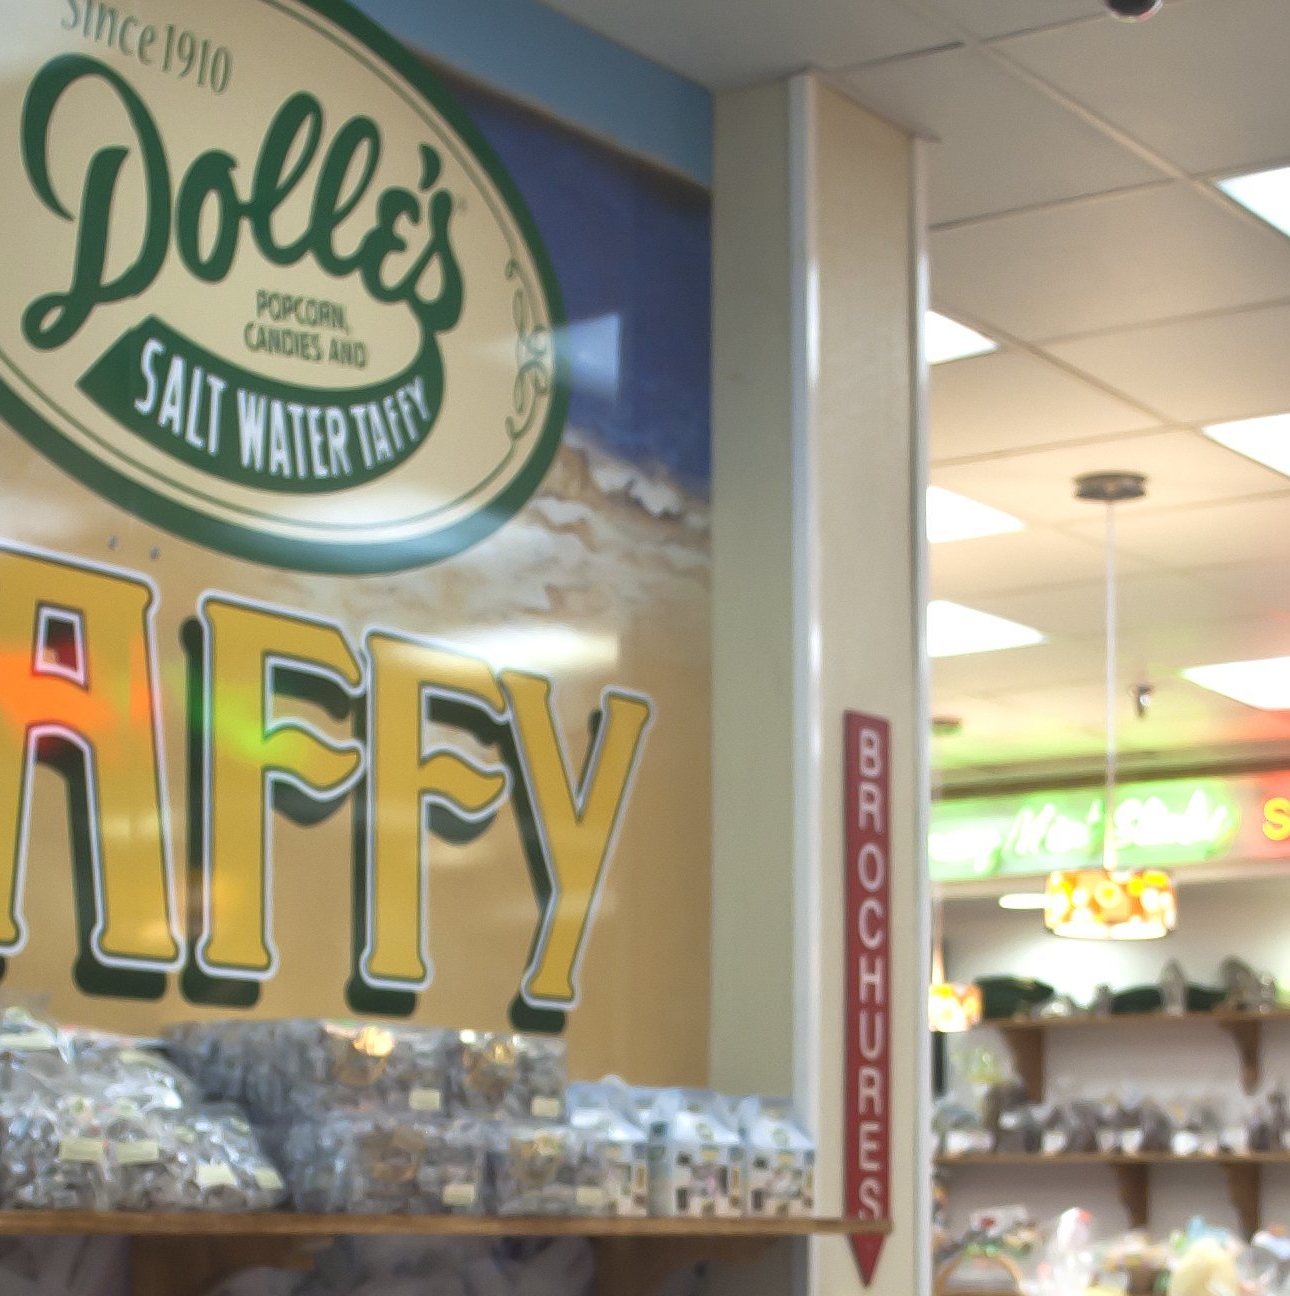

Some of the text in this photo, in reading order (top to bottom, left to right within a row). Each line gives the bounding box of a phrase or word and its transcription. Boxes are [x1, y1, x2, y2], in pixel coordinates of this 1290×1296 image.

[61, 0, 233, 94] Since 1910
[21, 53, 463, 350] Dolle's
[244, 320, 367, 370] CANDIES AND
[256, 289, 350, 335] POPCORN,
[133, 337, 431, 480] SALT WATER TAFFY
[858, 728, 883, 1220] BROCHURES
